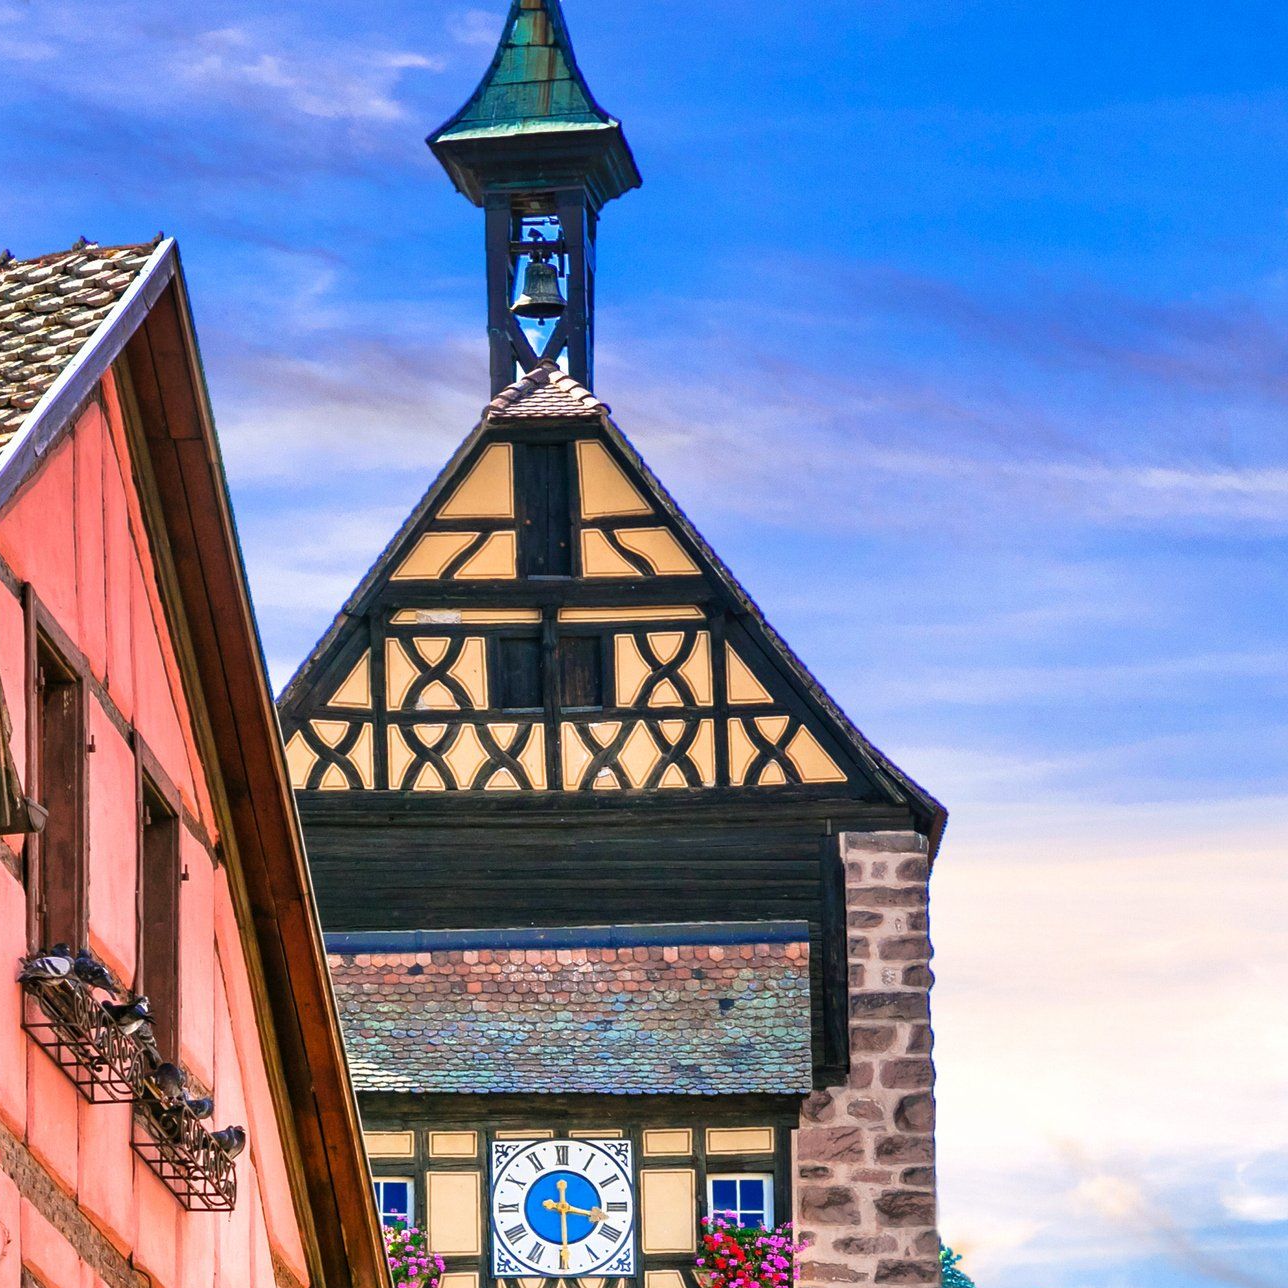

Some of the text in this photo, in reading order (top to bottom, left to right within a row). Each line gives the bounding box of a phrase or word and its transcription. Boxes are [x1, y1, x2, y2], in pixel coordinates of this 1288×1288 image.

[525, 1152, 545, 1173] XI
[554, 1146, 569, 1166] XII
[583, 1153, 596, 1171] I
[505, 1174, 527, 1190] X
[599, 1173, 619, 1188] II
[498, 1203, 519, 1213] IX
[607, 1202, 627, 1212] III
[504, 1223, 528, 1246] VIII
[598, 1222, 622, 1243] IIII
[526, 1241, 545, 1264] VII
[585, 1244, 600, 1262] V
